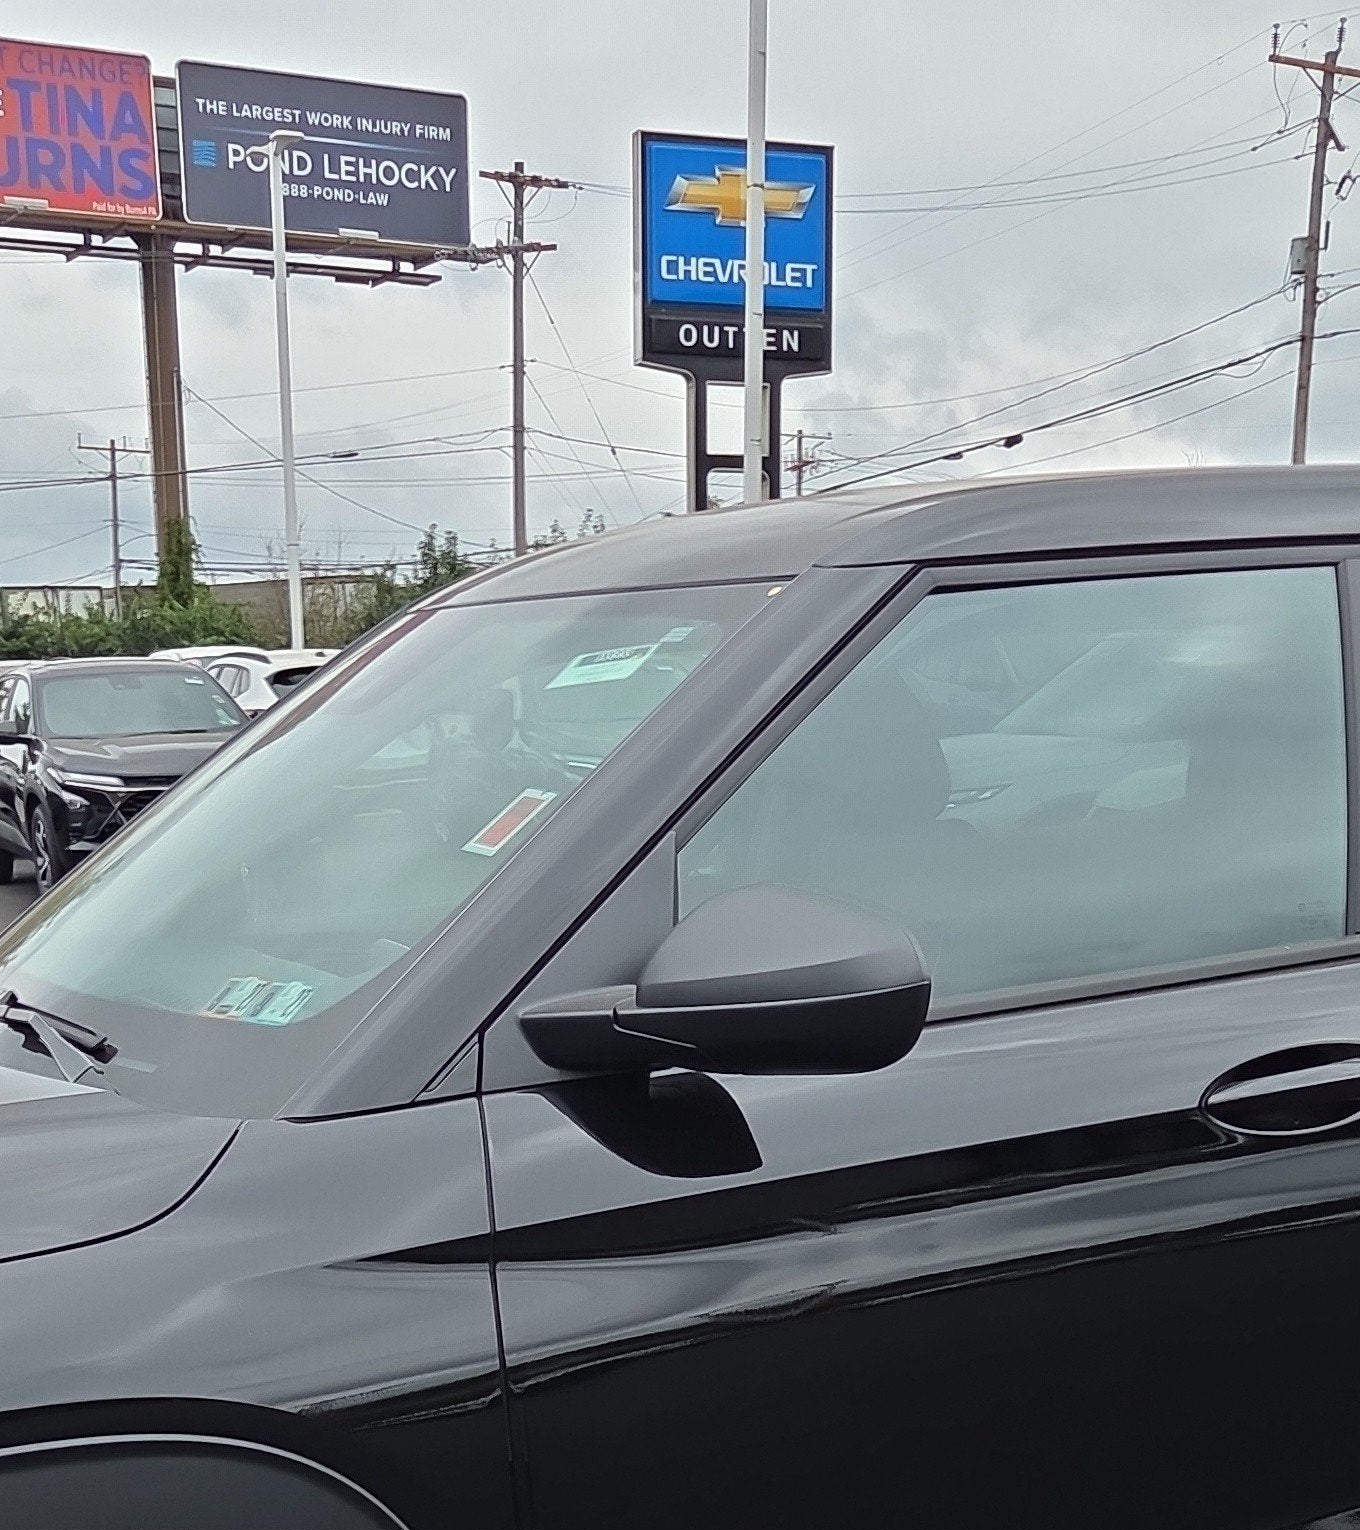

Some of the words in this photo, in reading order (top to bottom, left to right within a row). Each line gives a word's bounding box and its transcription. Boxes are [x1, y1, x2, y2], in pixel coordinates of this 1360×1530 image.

[18, 50, 145, 84] CHANGE?
[7, 78, 150, 144] TINA
[195, 98, 227, 115] THE
[232, 103, 301, 124] LARGEST
[306, 111, 352, 130] WORK
[357, 117, 411, 137] INJURY
[415, 124, 451, 142] FIRM
[323, 153, 457, 192] LEHOCKY
[678, 323, 800, 353] OUTEN
